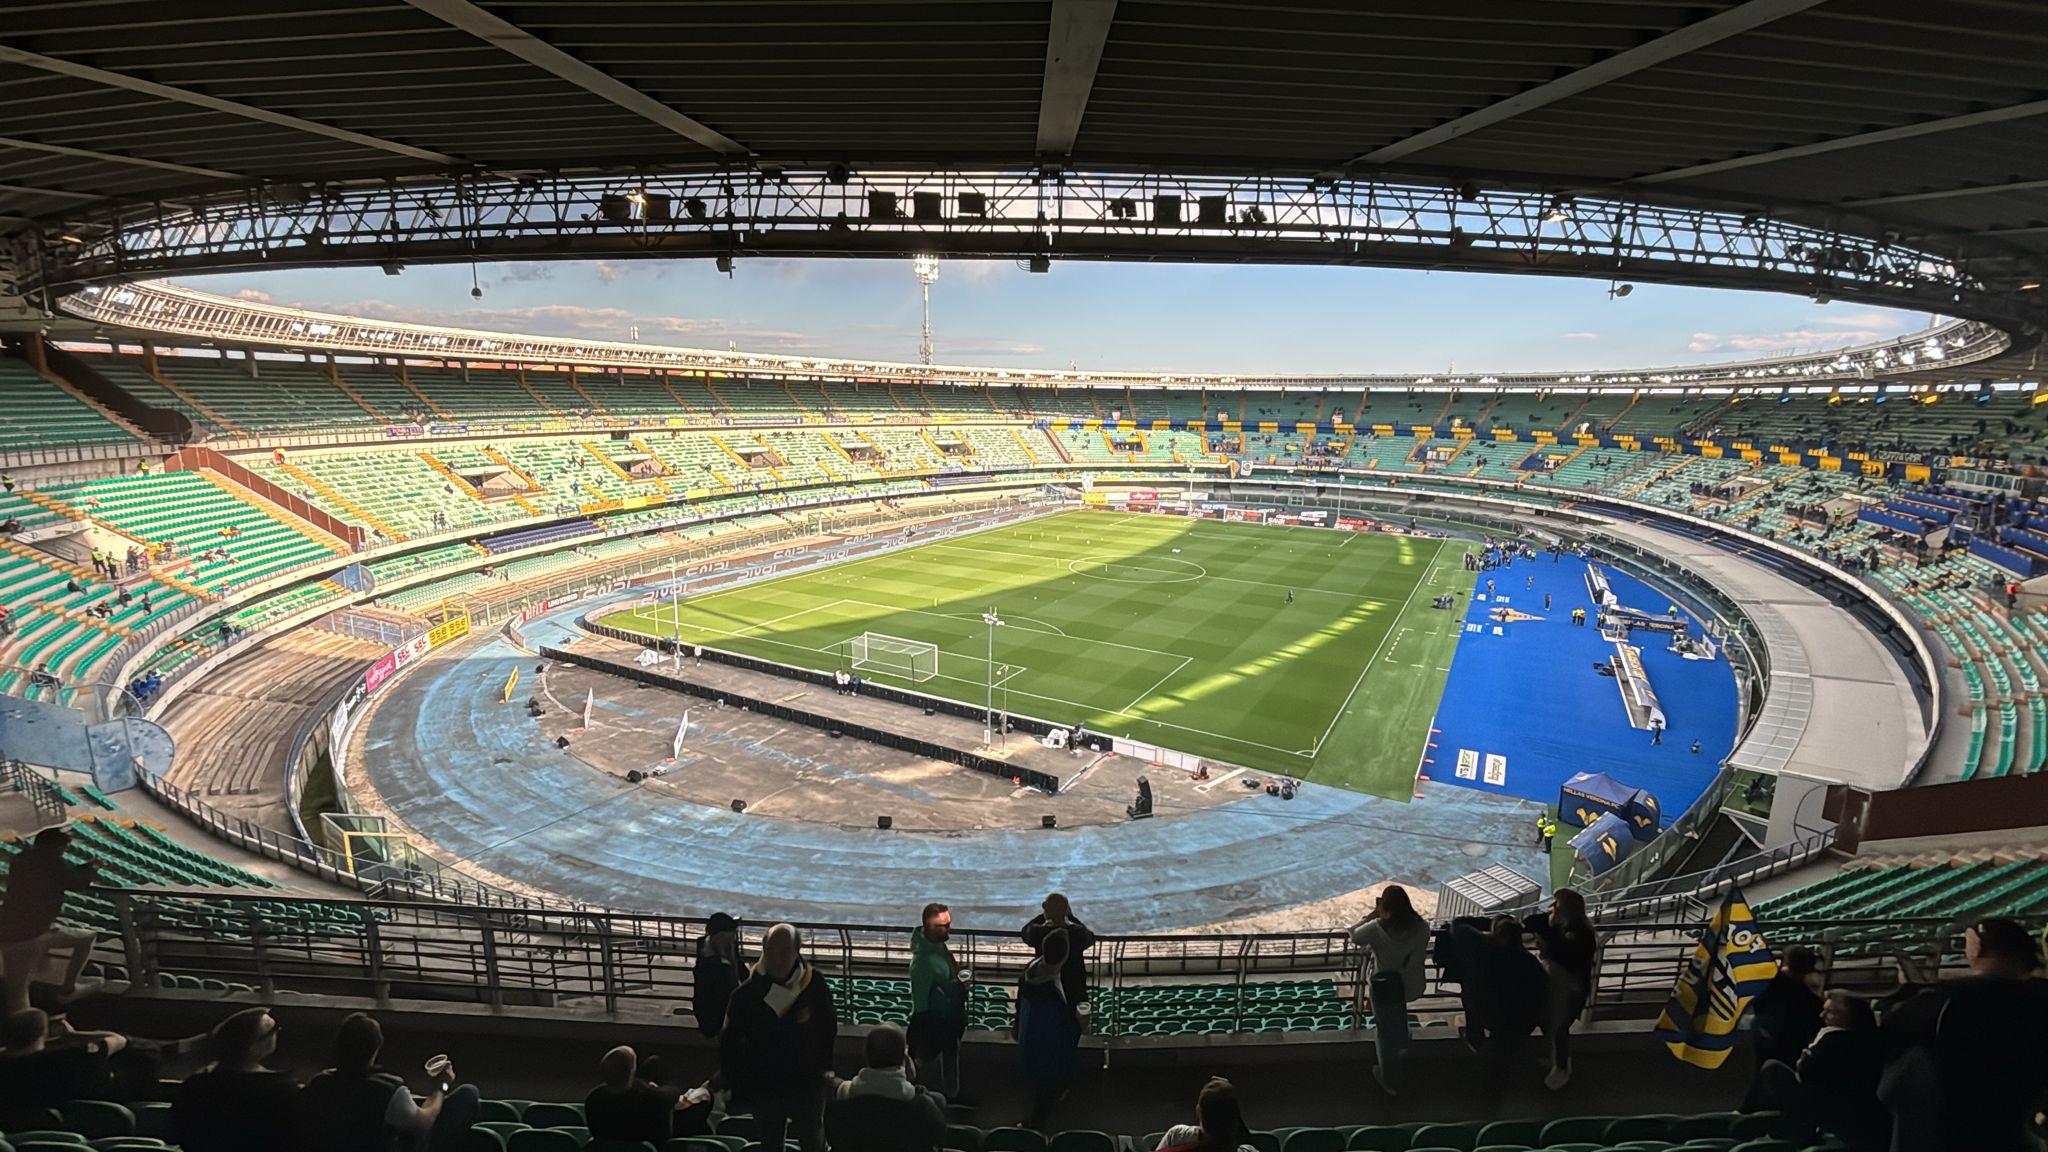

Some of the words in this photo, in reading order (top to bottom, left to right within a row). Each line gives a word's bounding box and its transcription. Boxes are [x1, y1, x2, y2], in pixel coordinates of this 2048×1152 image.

[414, 635, 427, 653] SEC
[397, 645, 410, 663] SEC
[1563, 786, 1586, 798] HELLAS
